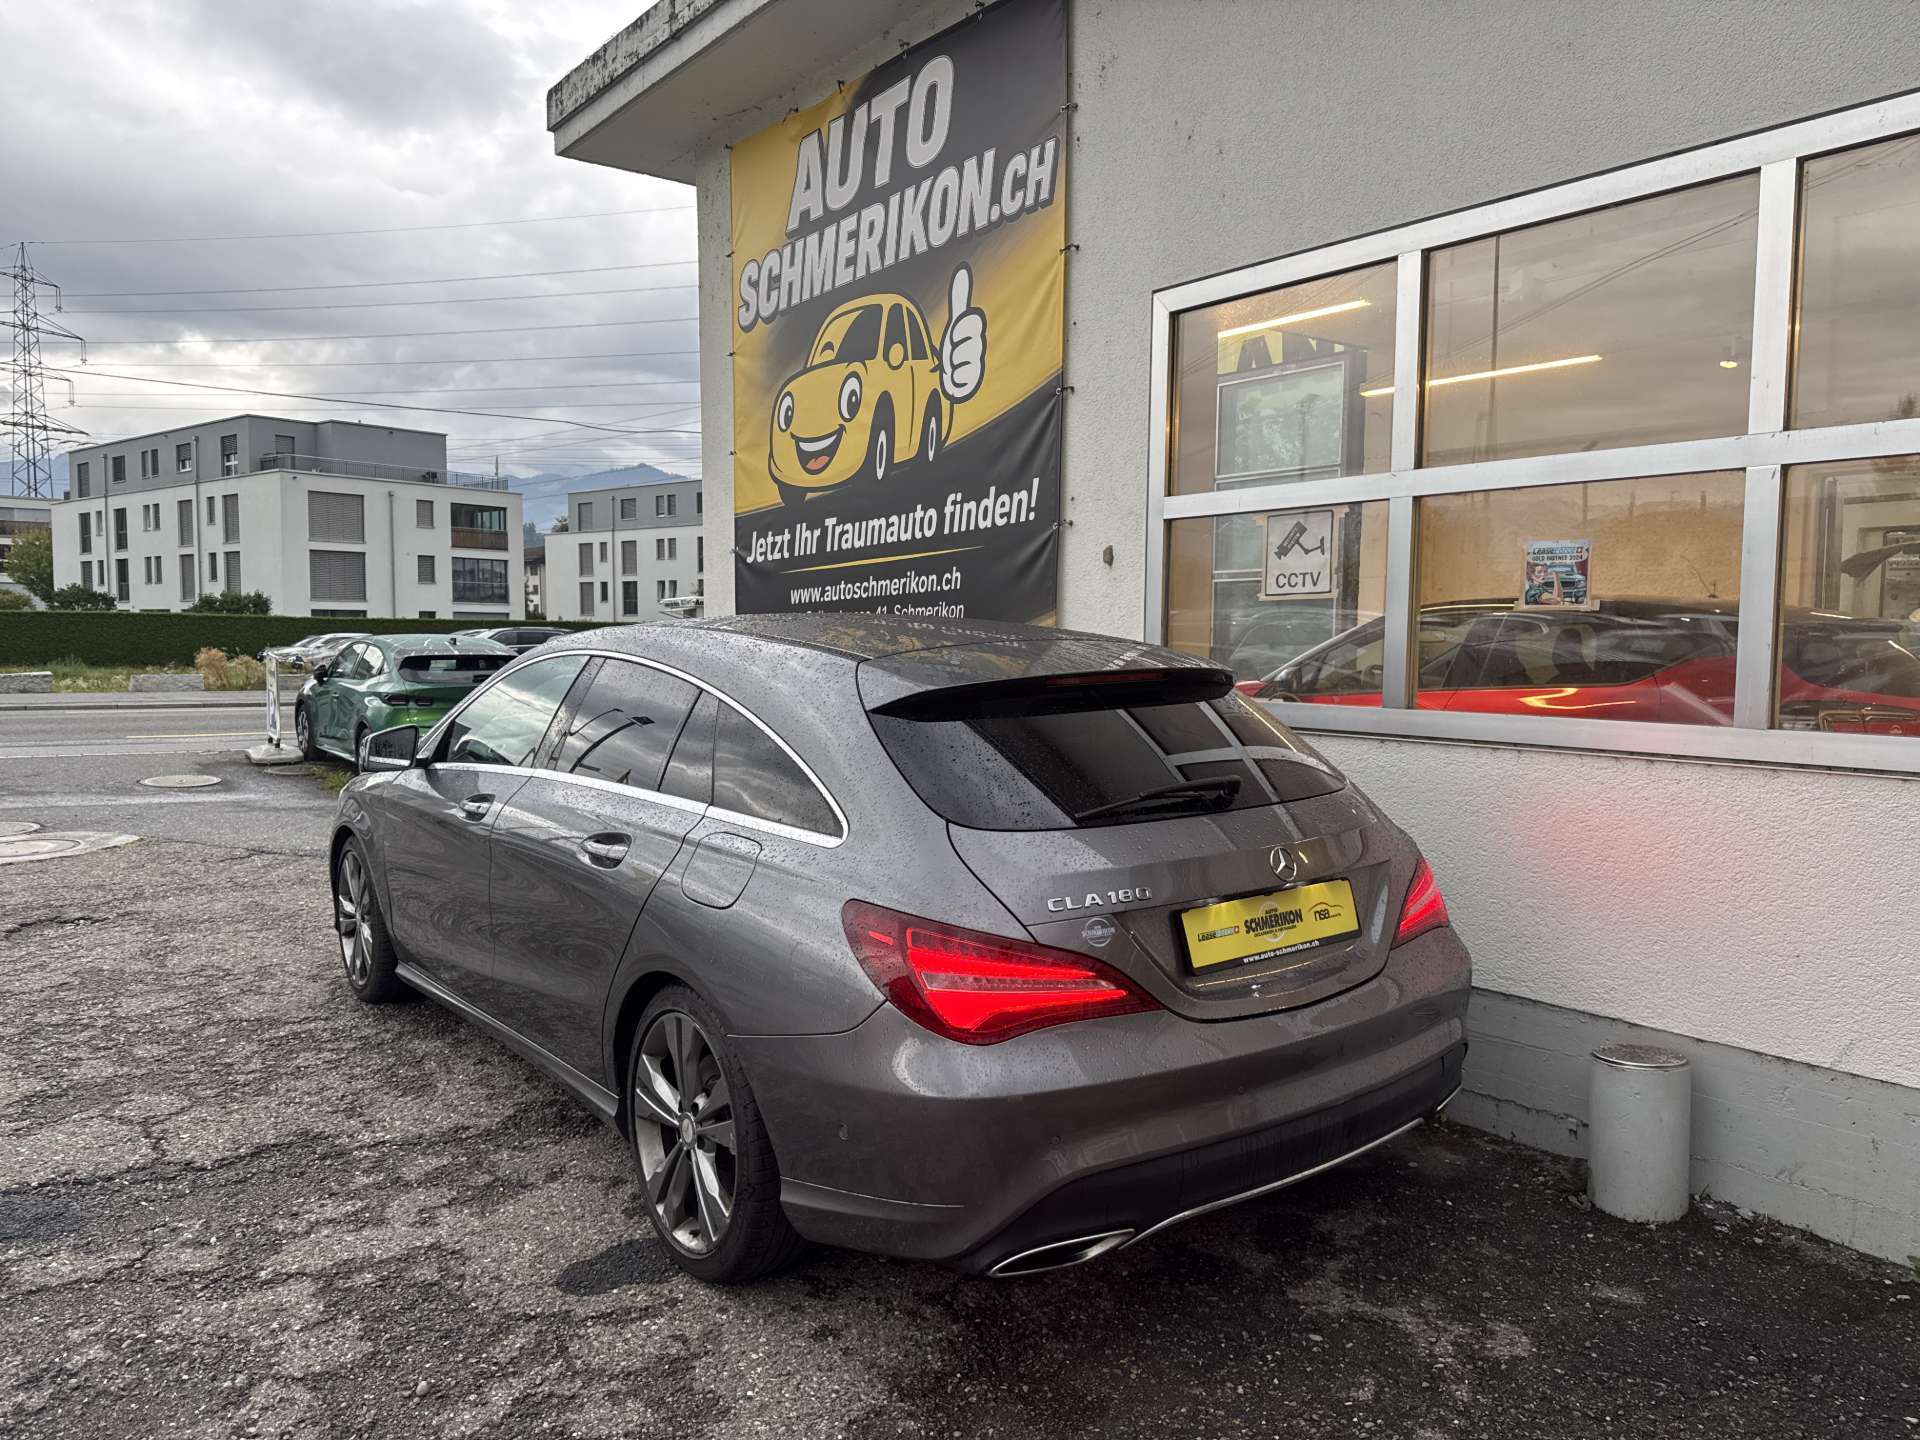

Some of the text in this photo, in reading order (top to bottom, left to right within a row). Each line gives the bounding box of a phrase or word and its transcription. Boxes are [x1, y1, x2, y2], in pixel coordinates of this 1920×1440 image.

[786, 54, 954, 234] AUTO
[738, 137, 1057, 330] SCHMERIKON.CH
[746, 477, 1040, 564] Jetzt Ihr Traumauto finden!
[790, 566, 961, 605] www.autoschmerikon.ch
[1275, 571, 1321, 589] CCTV
[1047, 886, 1153, 912] CLA 180
[1243, 908, 1304, 934] SCHMERIKON
